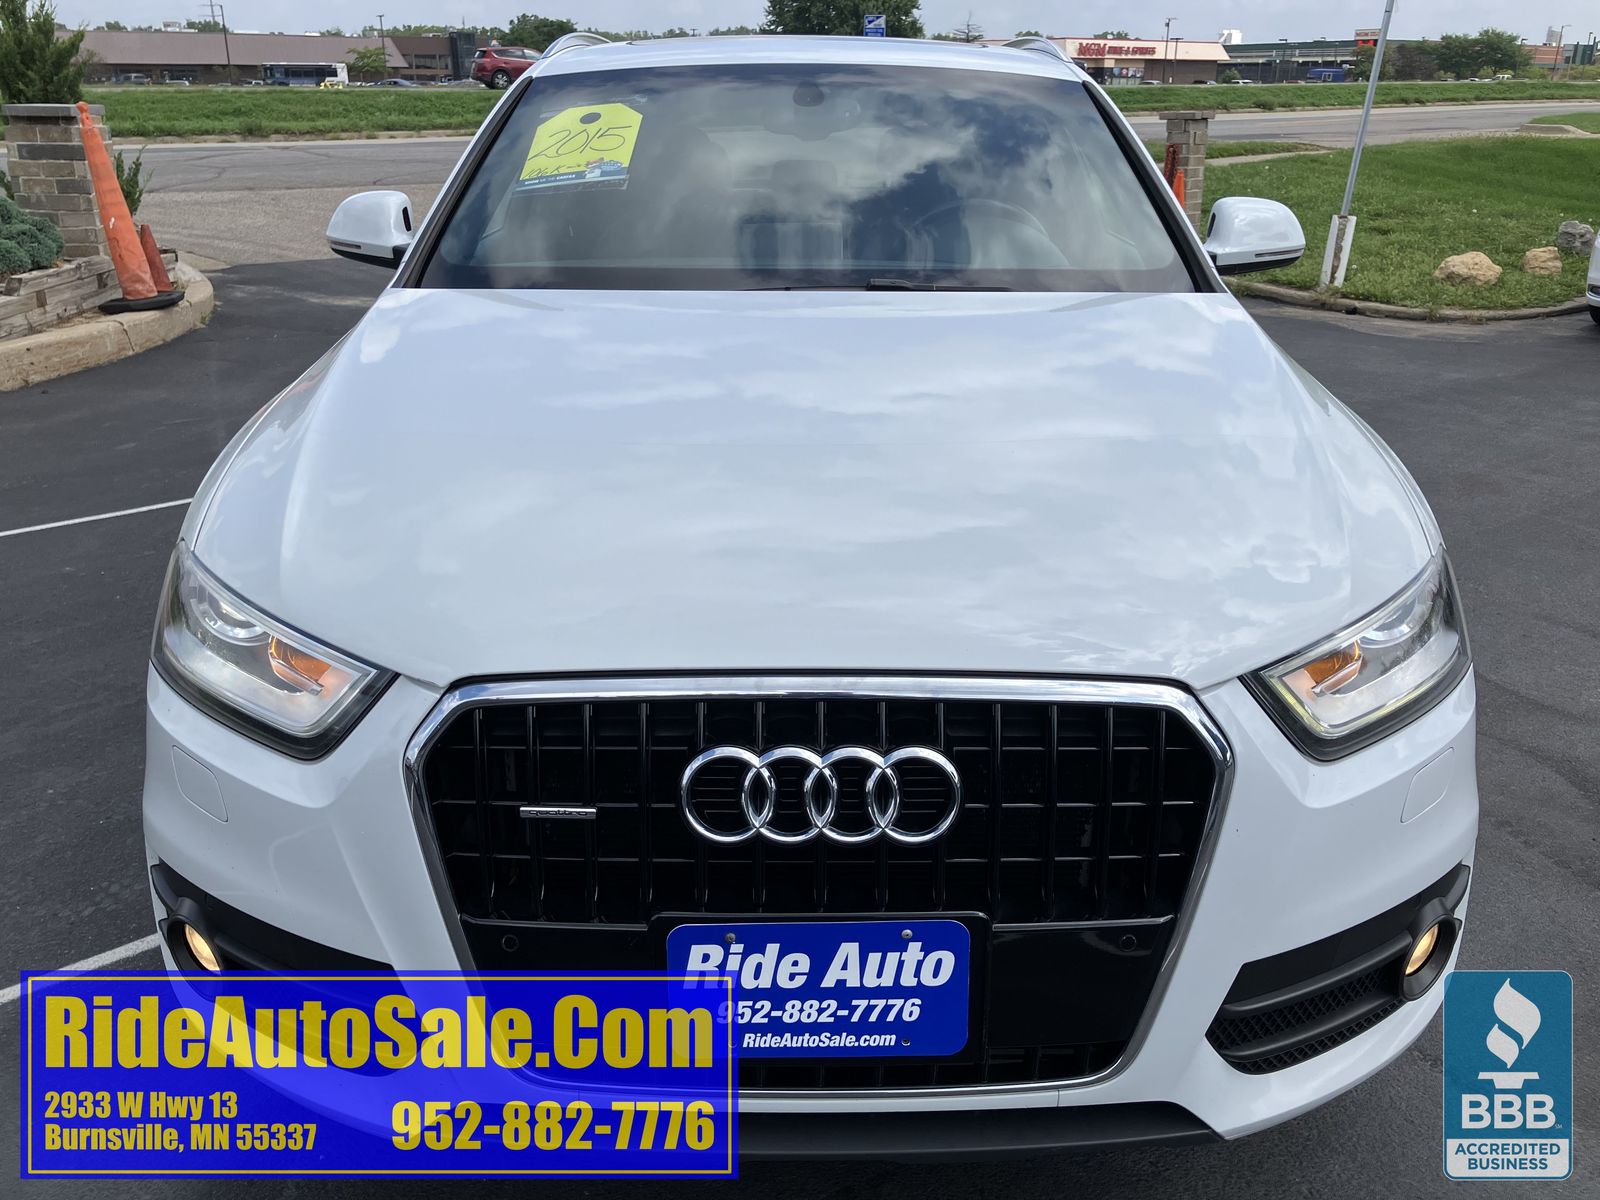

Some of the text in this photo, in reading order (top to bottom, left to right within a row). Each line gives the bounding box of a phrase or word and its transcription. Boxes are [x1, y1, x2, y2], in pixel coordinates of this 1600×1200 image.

[1077, 42, 1107, 57] MGM
[528, 125, 633, 161] 2015
[683, 941, 956, 990] Ride Auto
[716, 998, 922, 1025] 952-882-7776
[742, 1032, 897, 1048] RideAutoSale.com
